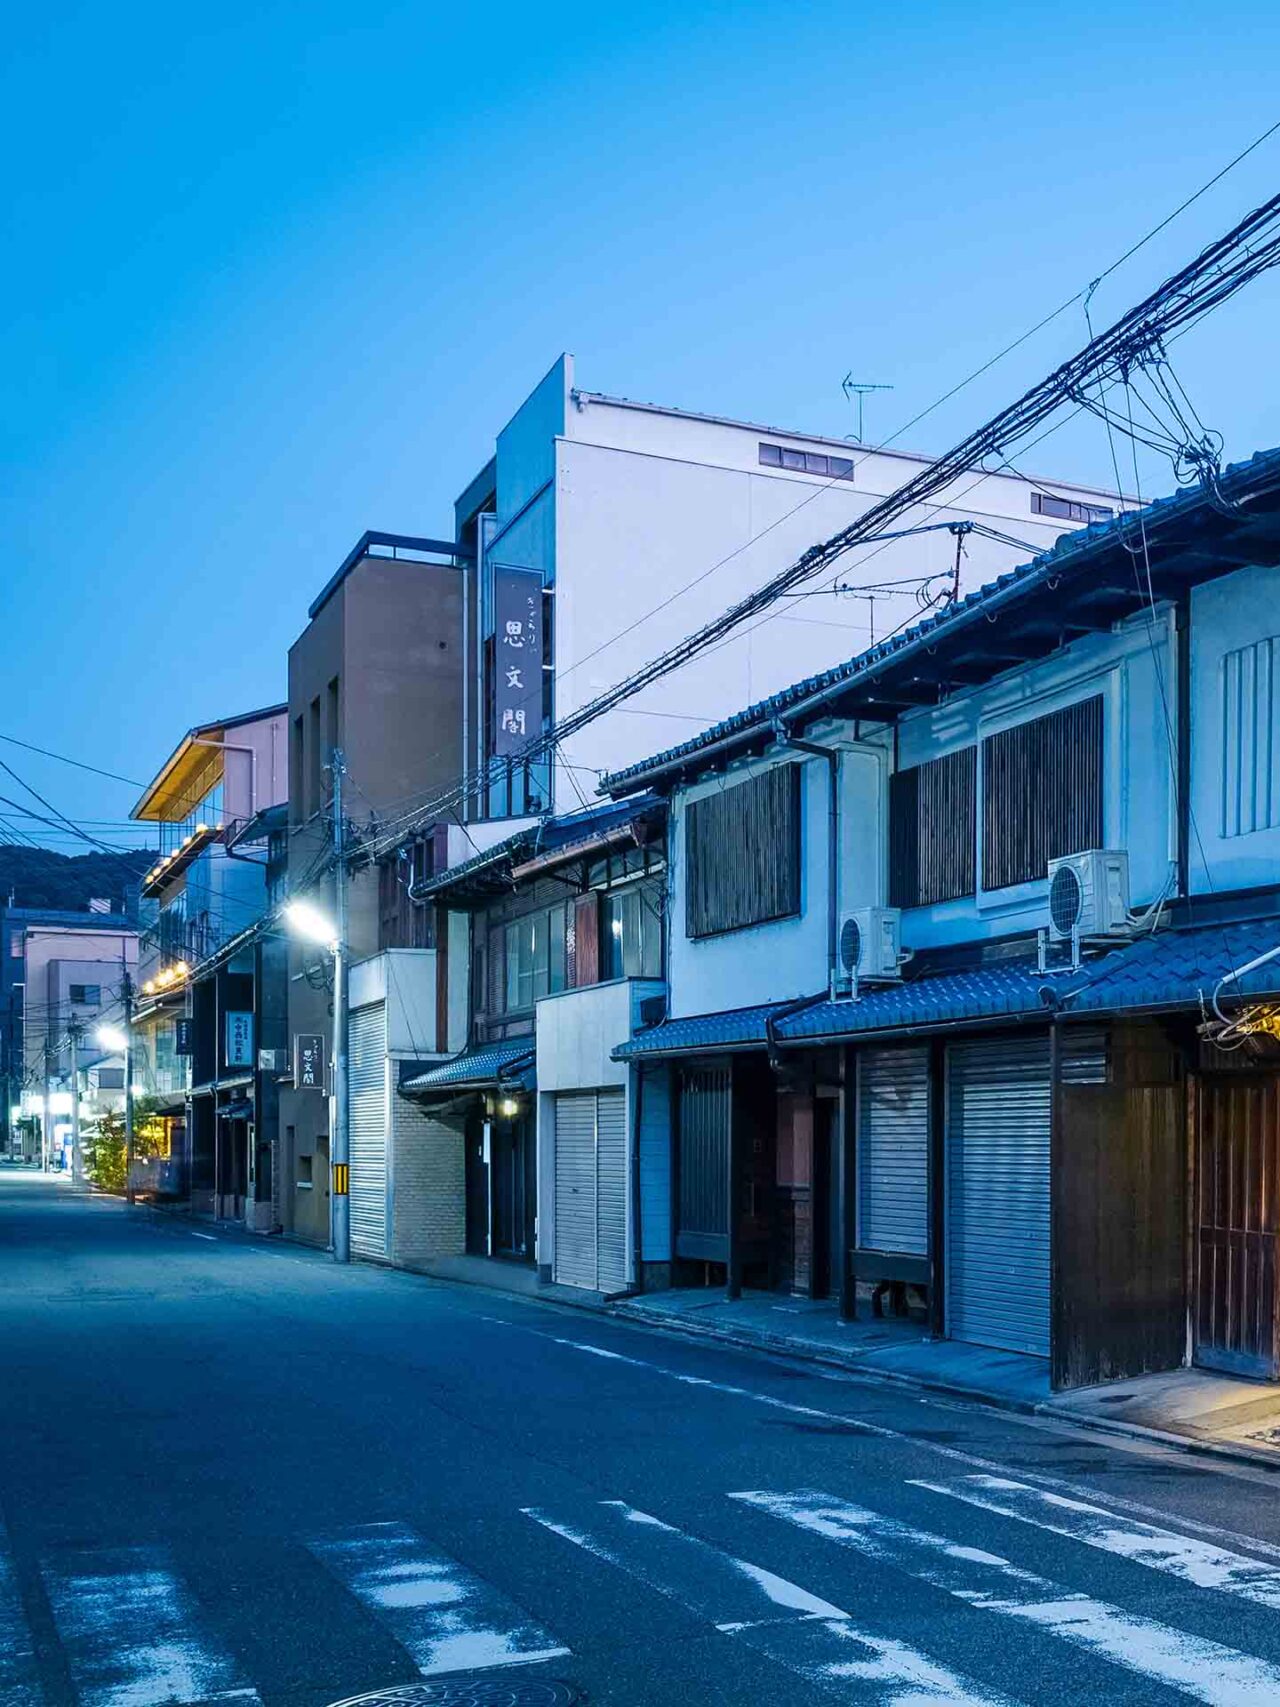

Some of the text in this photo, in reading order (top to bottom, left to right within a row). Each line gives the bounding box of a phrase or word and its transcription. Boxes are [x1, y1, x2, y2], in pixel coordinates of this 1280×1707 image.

[502, 620, 526, 735] 思文閣
[303, 1049, 314, 1084] 思文閣
